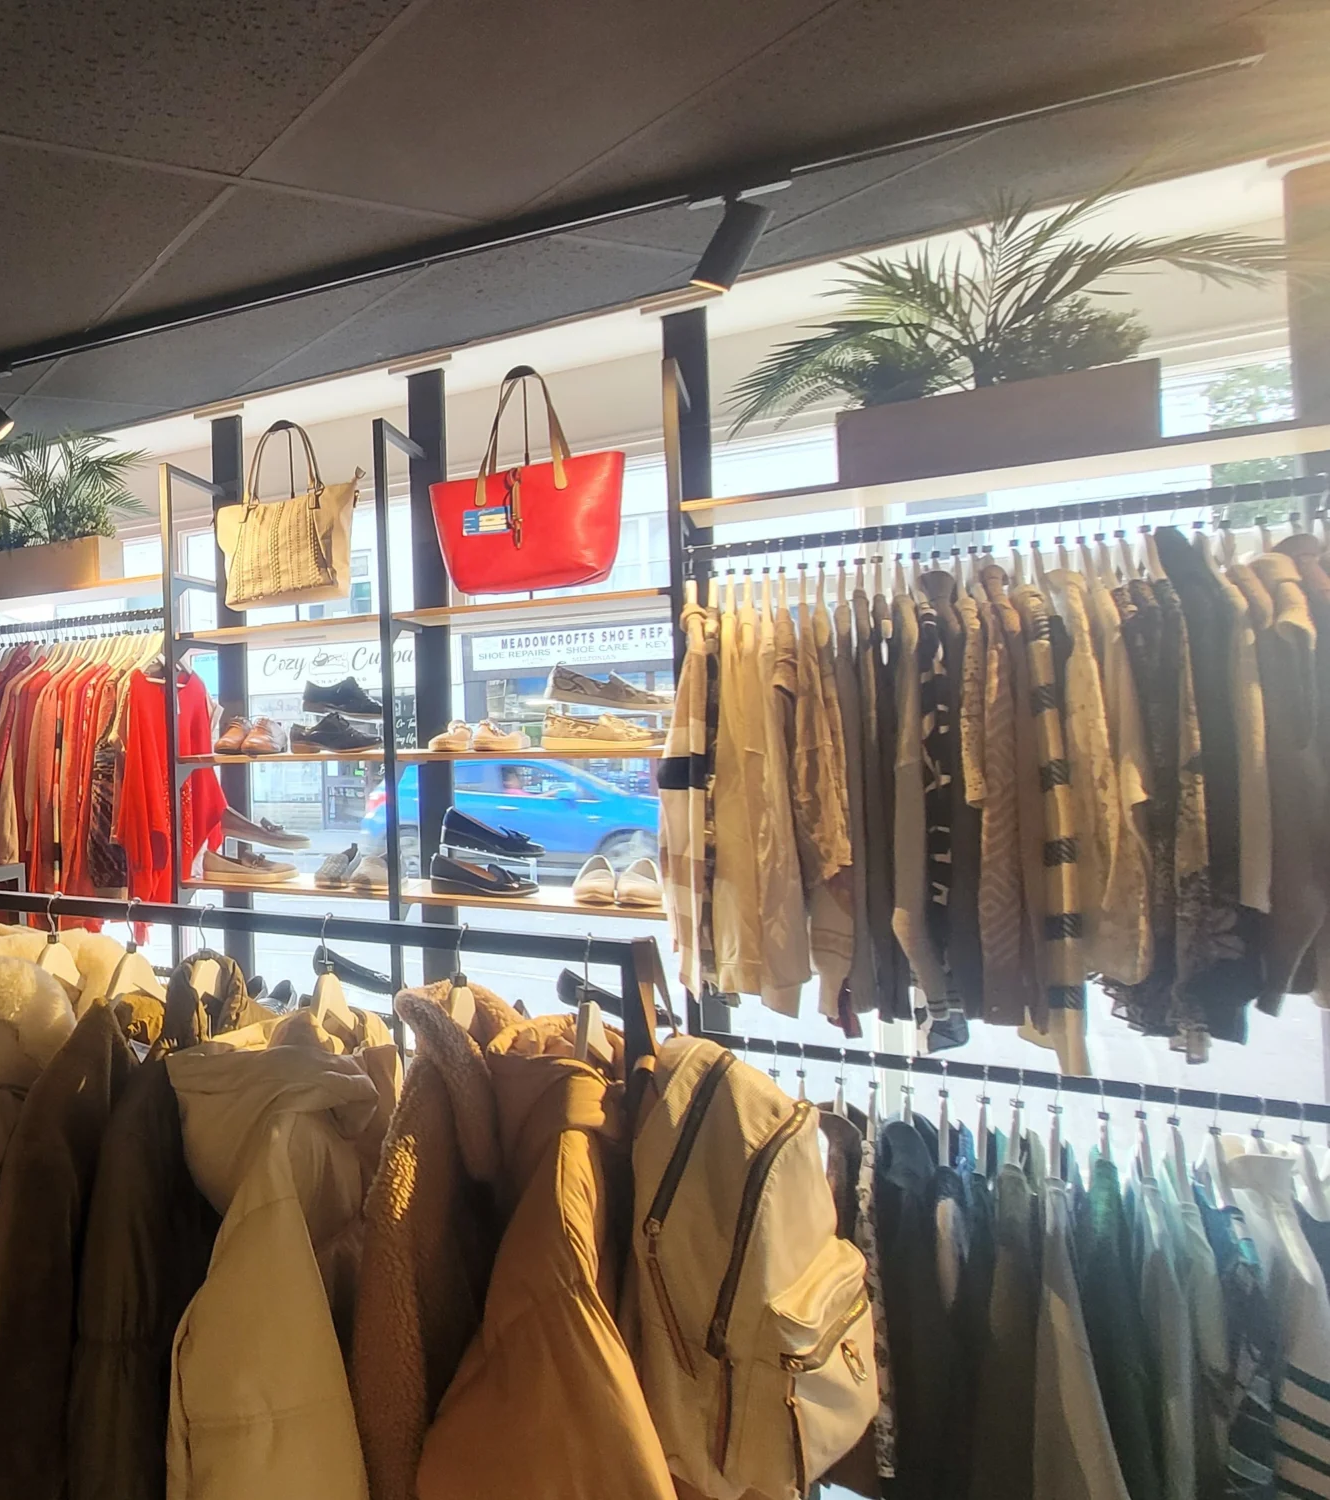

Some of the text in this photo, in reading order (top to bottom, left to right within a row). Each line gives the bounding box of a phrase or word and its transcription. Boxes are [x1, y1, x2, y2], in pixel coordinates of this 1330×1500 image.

[501, 632, 595, 649] MEADOWCROFTS
[601, 628, 634, 643] SHOE
[478, 640, 668, 660] SHOE REPAIRS SHOE CARE KEY
[263, 646, 414, 681] Cozy Cupa
